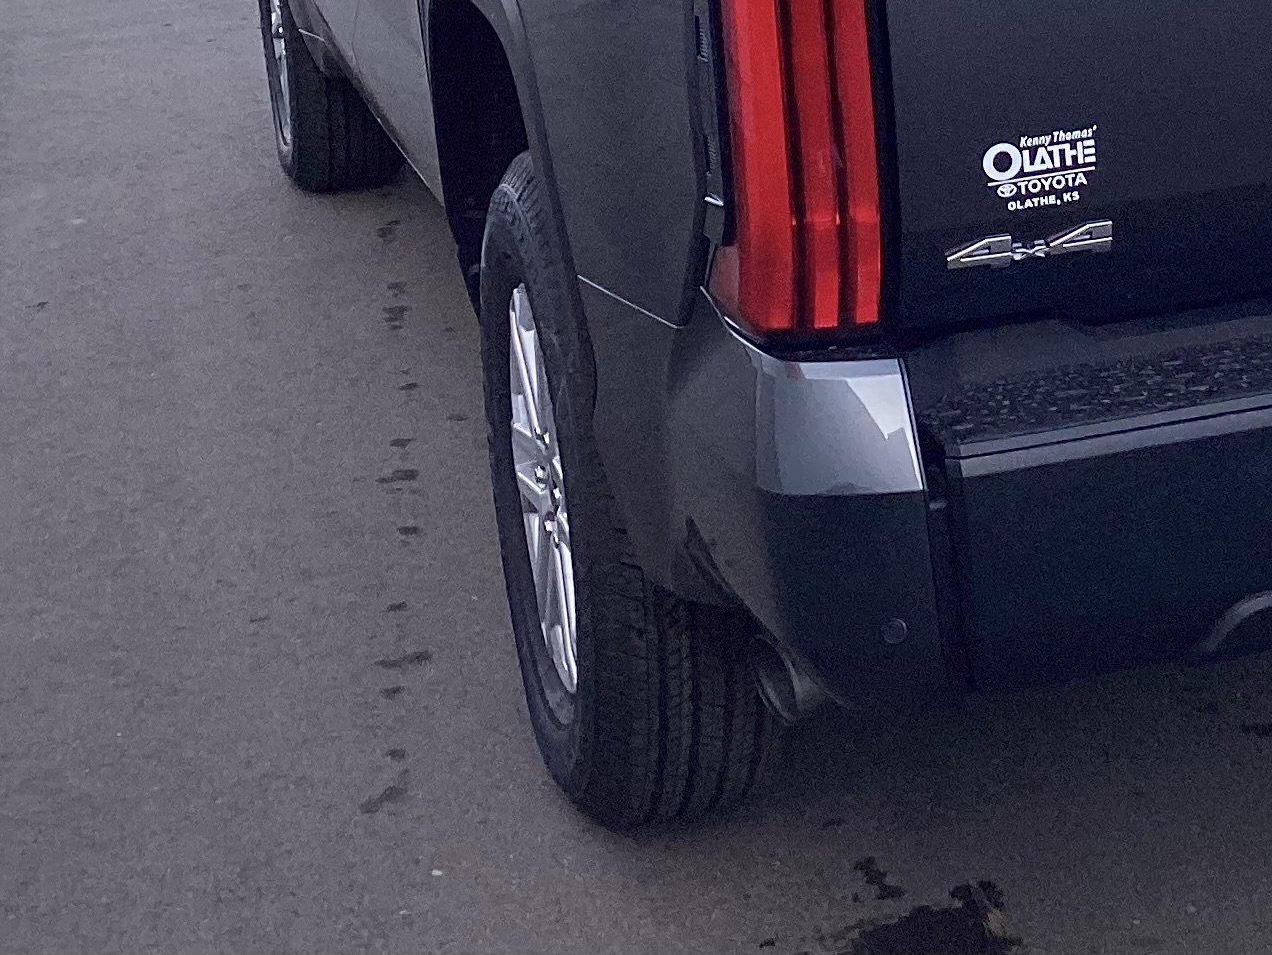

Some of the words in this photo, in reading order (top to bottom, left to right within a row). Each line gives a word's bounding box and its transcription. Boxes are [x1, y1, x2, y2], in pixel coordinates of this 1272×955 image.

[1020, 133, 1052, 148] Kenny
[982, 139, 1097, 181] OLATHE
[1018, 173, 1088, 195] TOYOTA
[1007, 195, 1061, 211] OLATHE,
[1063, 191, 1080, 203] KS
